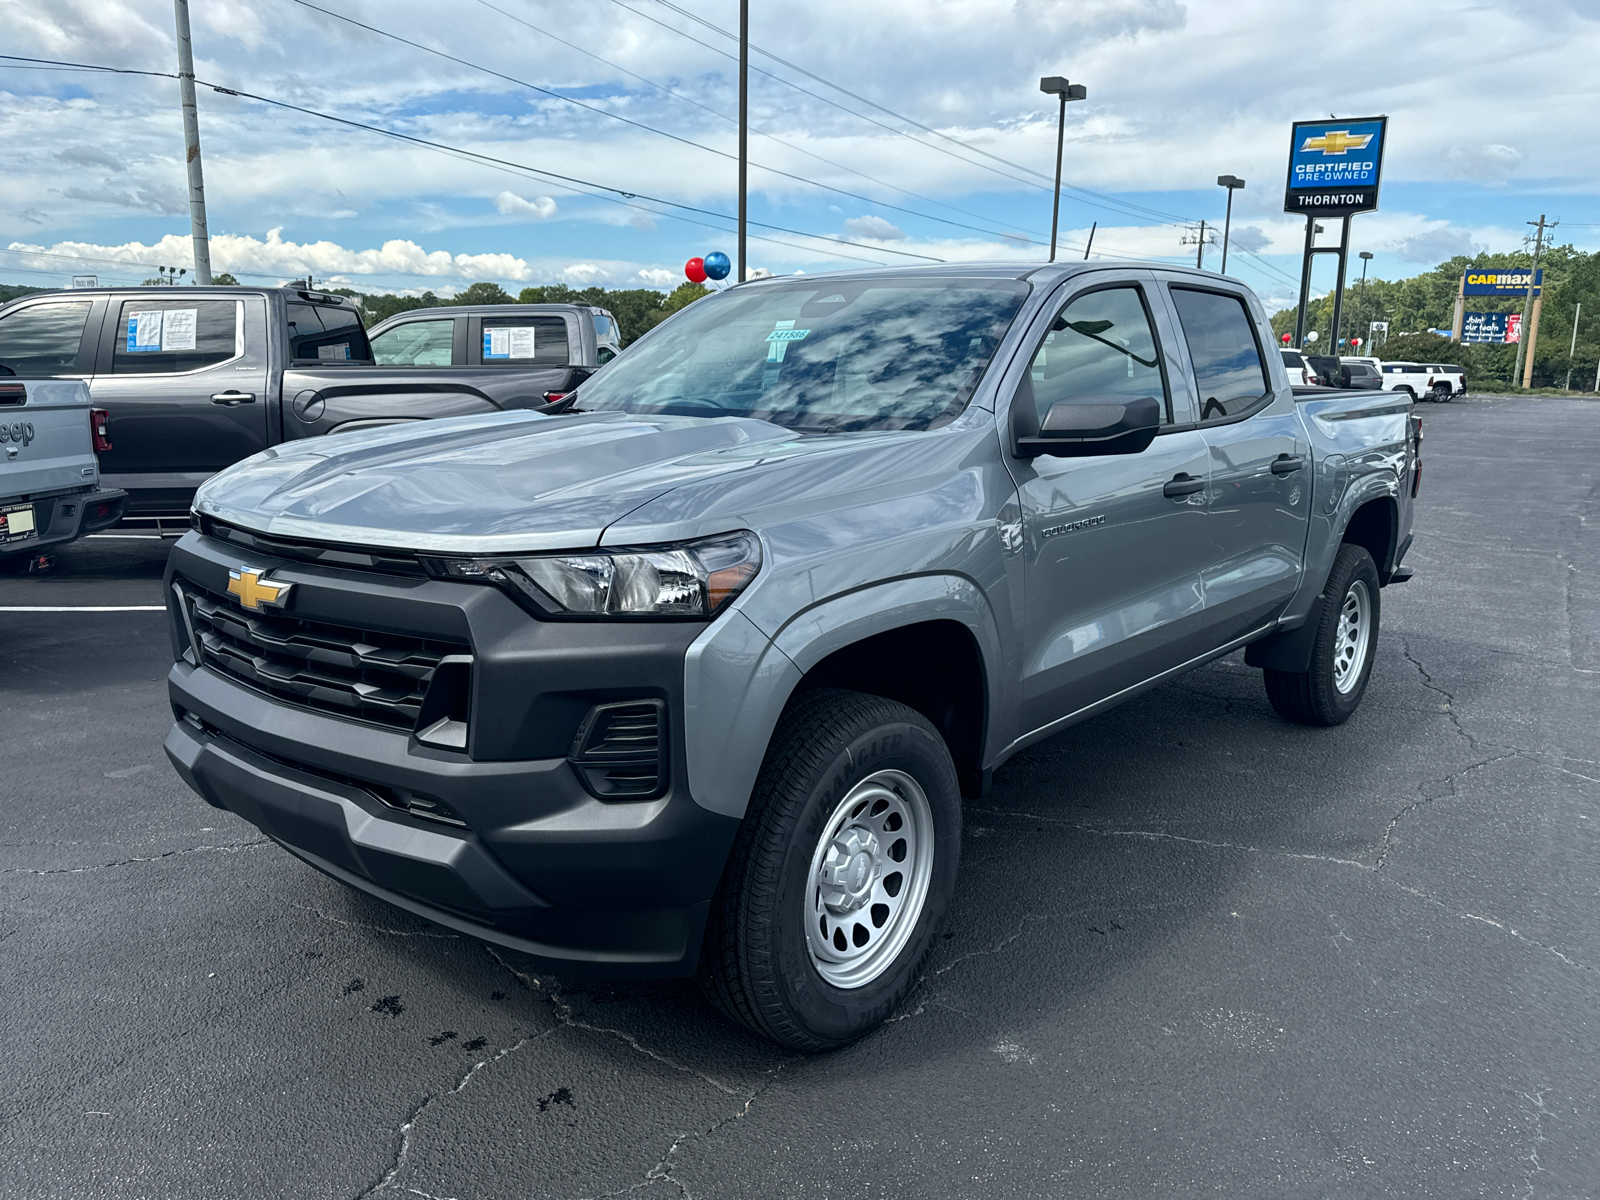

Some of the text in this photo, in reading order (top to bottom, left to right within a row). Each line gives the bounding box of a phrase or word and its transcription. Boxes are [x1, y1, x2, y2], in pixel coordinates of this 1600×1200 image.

[1295, 162, 1373, 173] CERTIFIED
[1298, 171, 1368, 181] PRE-OWNED
[1298, 194, 1364, 205] THORNTON
[769, 331, 808, 339] 241586
[0, 421, 34, 447] eep
[1042, 514, 1106, 538] COLORADO
[805, 733, 902, 838] WRANGLER
